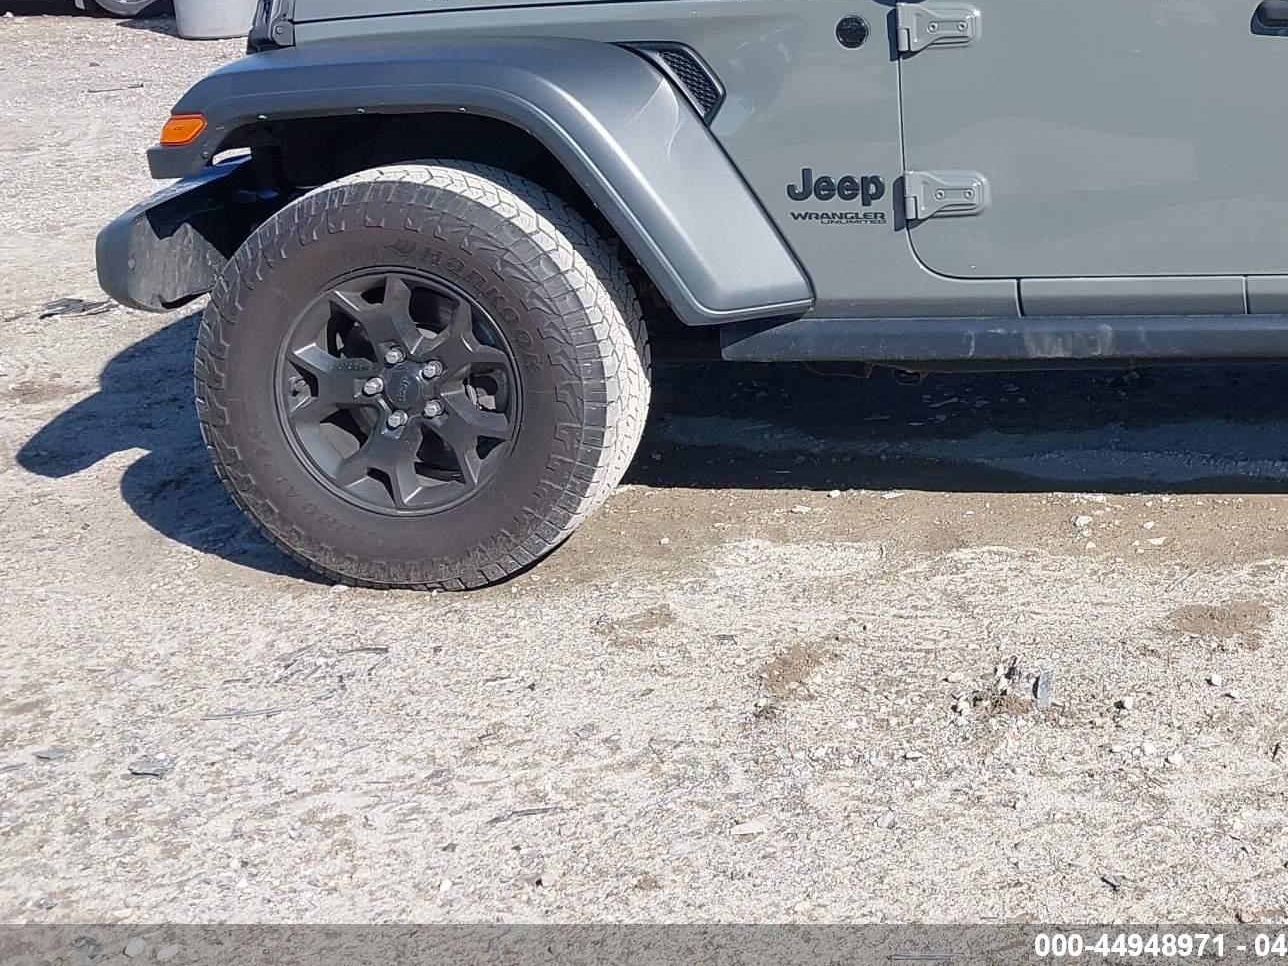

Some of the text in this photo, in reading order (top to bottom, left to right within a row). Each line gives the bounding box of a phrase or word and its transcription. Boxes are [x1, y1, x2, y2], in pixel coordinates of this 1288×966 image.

[786, 168, 886, 207] Jeep
[790, 211, 886, 221] WRANGLER
[395, 375, 411, 403] Jeep
